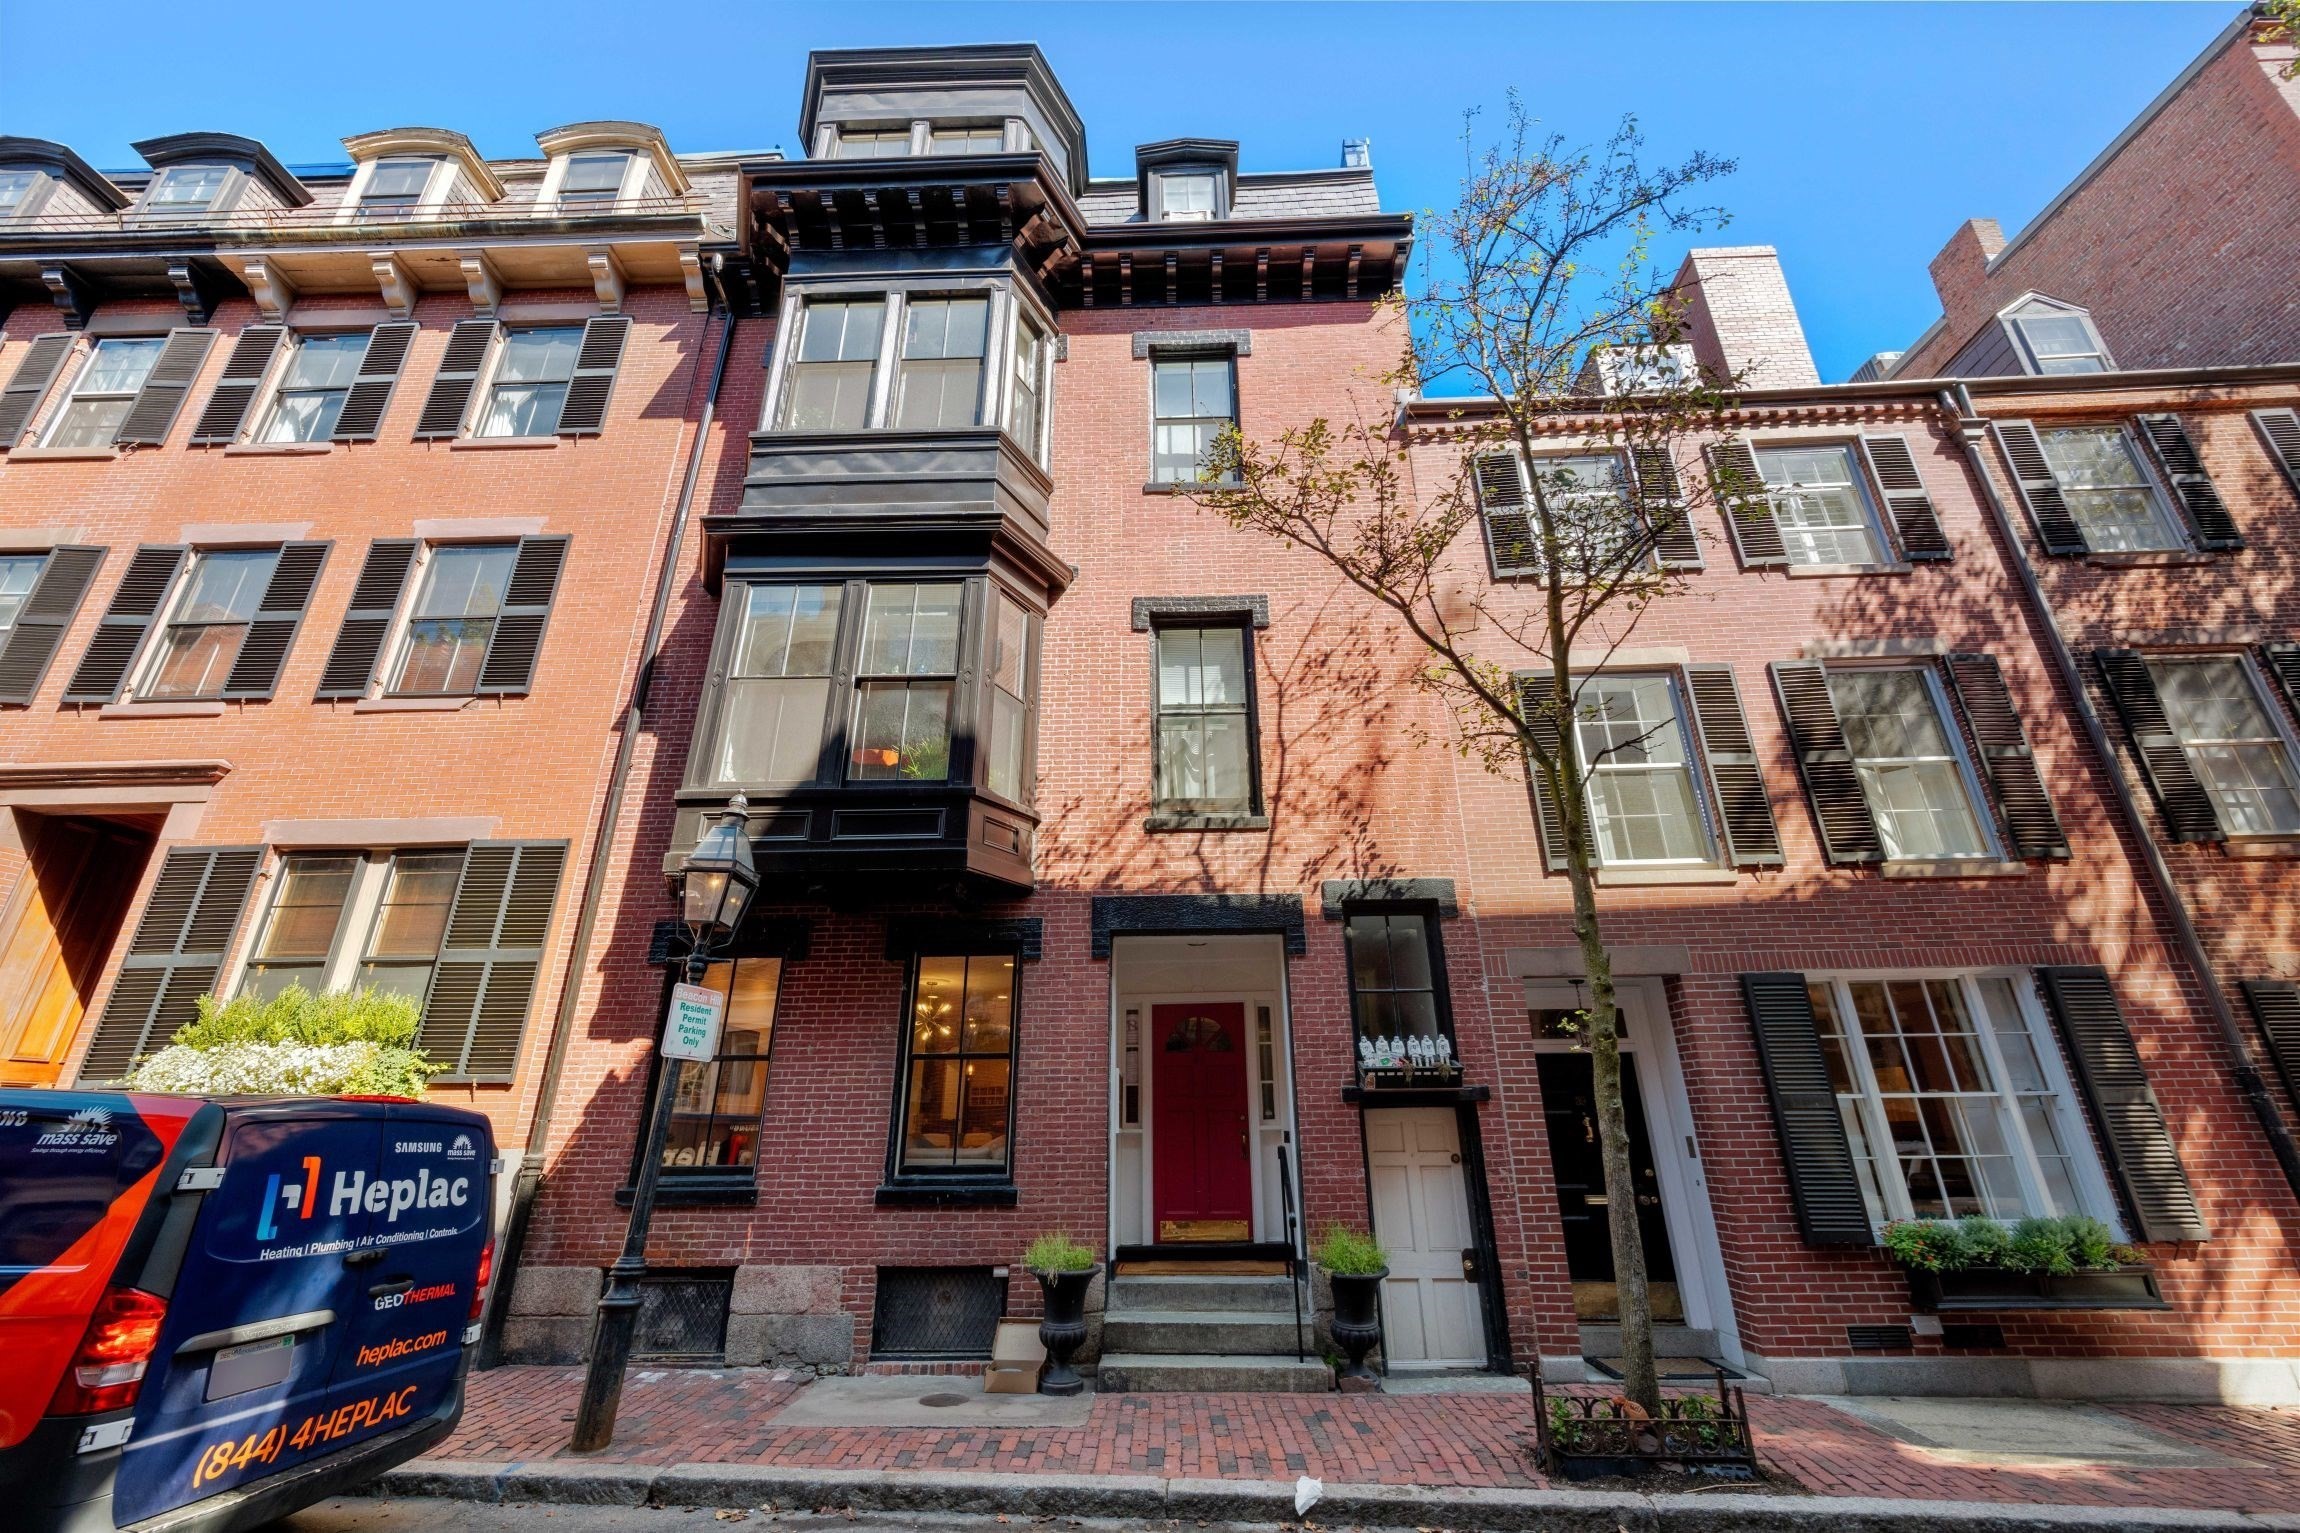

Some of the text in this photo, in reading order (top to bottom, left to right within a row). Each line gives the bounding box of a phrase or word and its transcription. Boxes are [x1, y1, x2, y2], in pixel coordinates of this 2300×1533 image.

[676, 988, 722, 1006] Beacon Hill
[680, 1002, 712, 1015] Resident
[682, 1013, 707, 1025] Permit
[678, 1024, 706, 1038] Parking
[682, 1036, 700, 1048] Only
[36, 1133, 118, 1145] mass save
[395, 1142, 442, 1153] SAMSUNG
[329, 1168, 469, 1223] Heplac
[260, 1247, 303, 1260] Heating
[310, 1239, 354, 1253] Plumbing
[360, 1235, 375, 1246] Air
[375, 1228, 424, 1245] Conditioning
[429, 1226, 458, 1238] Controls
[374, 1283, 456, 1311] GEOTHERMAL
[356, 1330, 447, 1367] heplac.com
[192, 1385, 418, 1489] (844) 4HEPLAC
